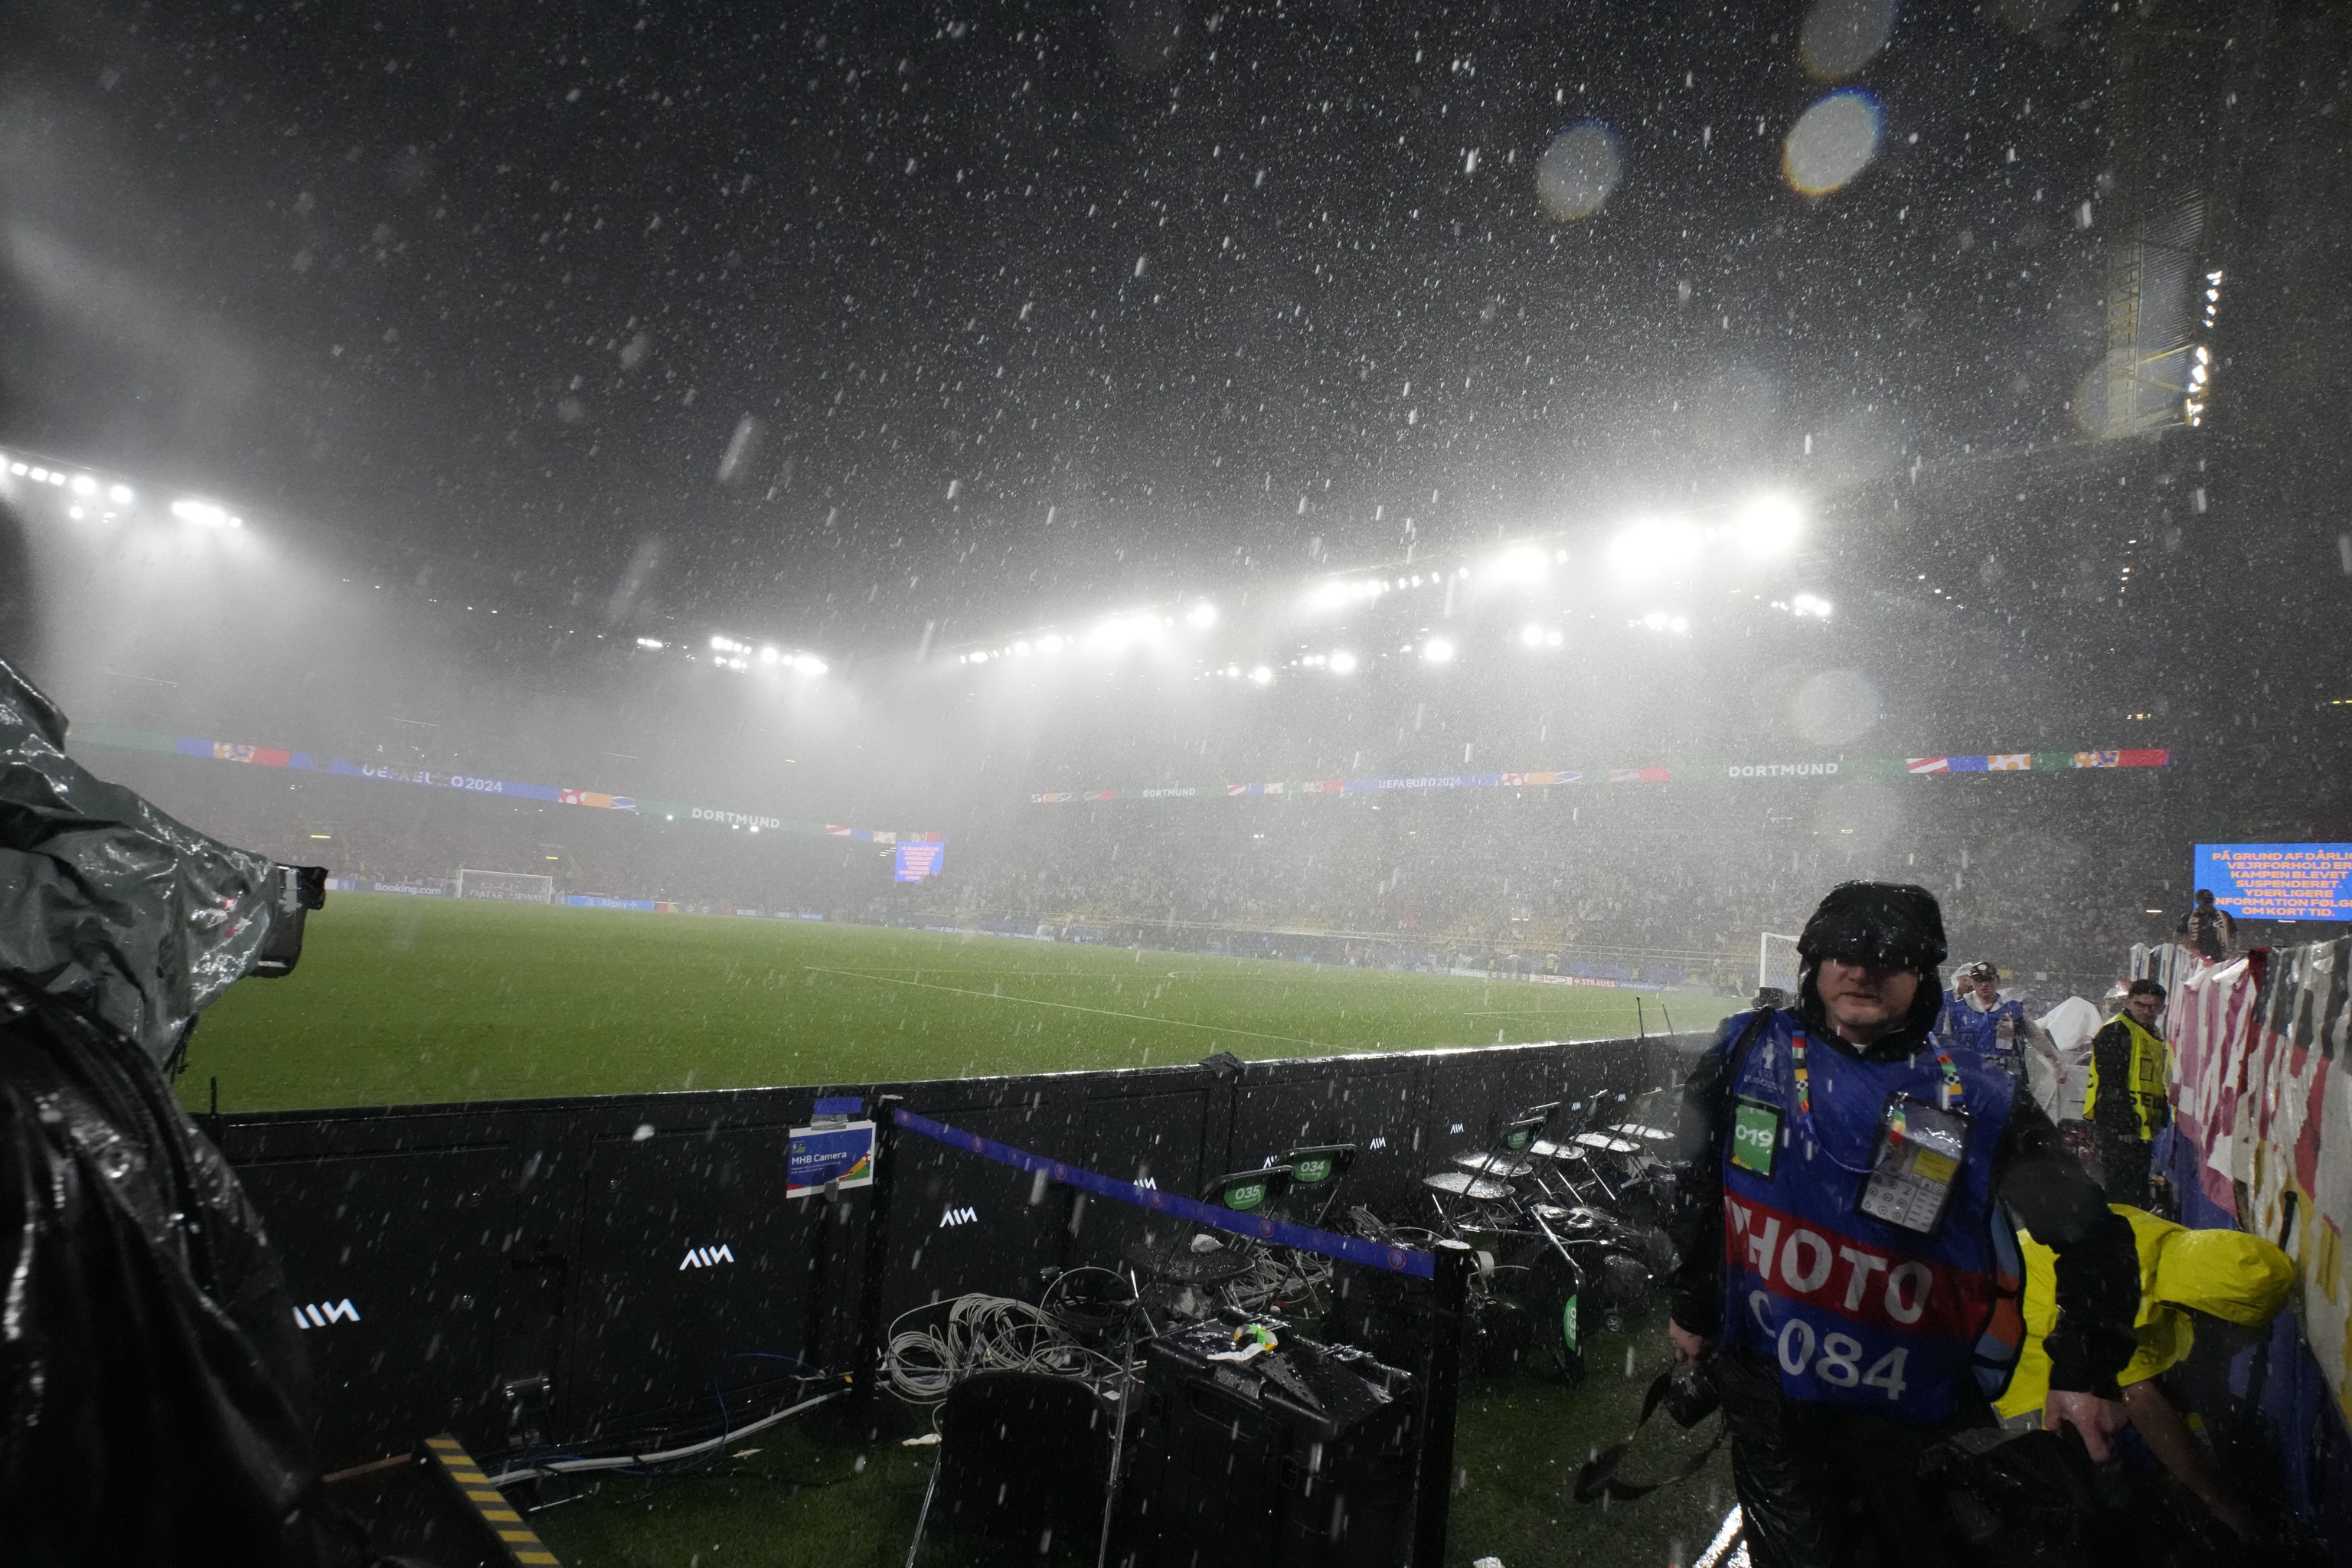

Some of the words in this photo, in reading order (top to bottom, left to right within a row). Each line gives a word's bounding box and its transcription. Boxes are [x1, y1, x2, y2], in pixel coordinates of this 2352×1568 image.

[1729, 763, 1838, 777] DORTMUND
[466, 778, 502, 792] 2024
[1438, 777, 1461, 787] 2024
[1143, 788, 1195, 798] DORTMUND
[691, 808, 780, 828] DORTMUND
[2212, 850, 2231, 861] PÅ
[2231, 871, 2290, 879] KAMPEN
[374, 883, 442, 895] Booking.com
[2236, 880, 2343, 888] SUSPENDERET.
[2245, 889, 2334, 897] YDERLIGERE
[2215, 898, 2309, 906] NFORMATION
[2266, 907, 2306, 916] KORT
[2308, 908, 2335, 916] TID.
[1452, 969, 1488, 978] Hisense
[1581, 979, 1615, 988] STRAUSS
[1736, 1124, 1774, 1147] 019
[792, 1155, 812, 1165] MHB
[814, 1152, 847, 1161] Camera
[1300, 1160, 1325, 1173] 034
[1235, 1185, 1260, 1200] 035
